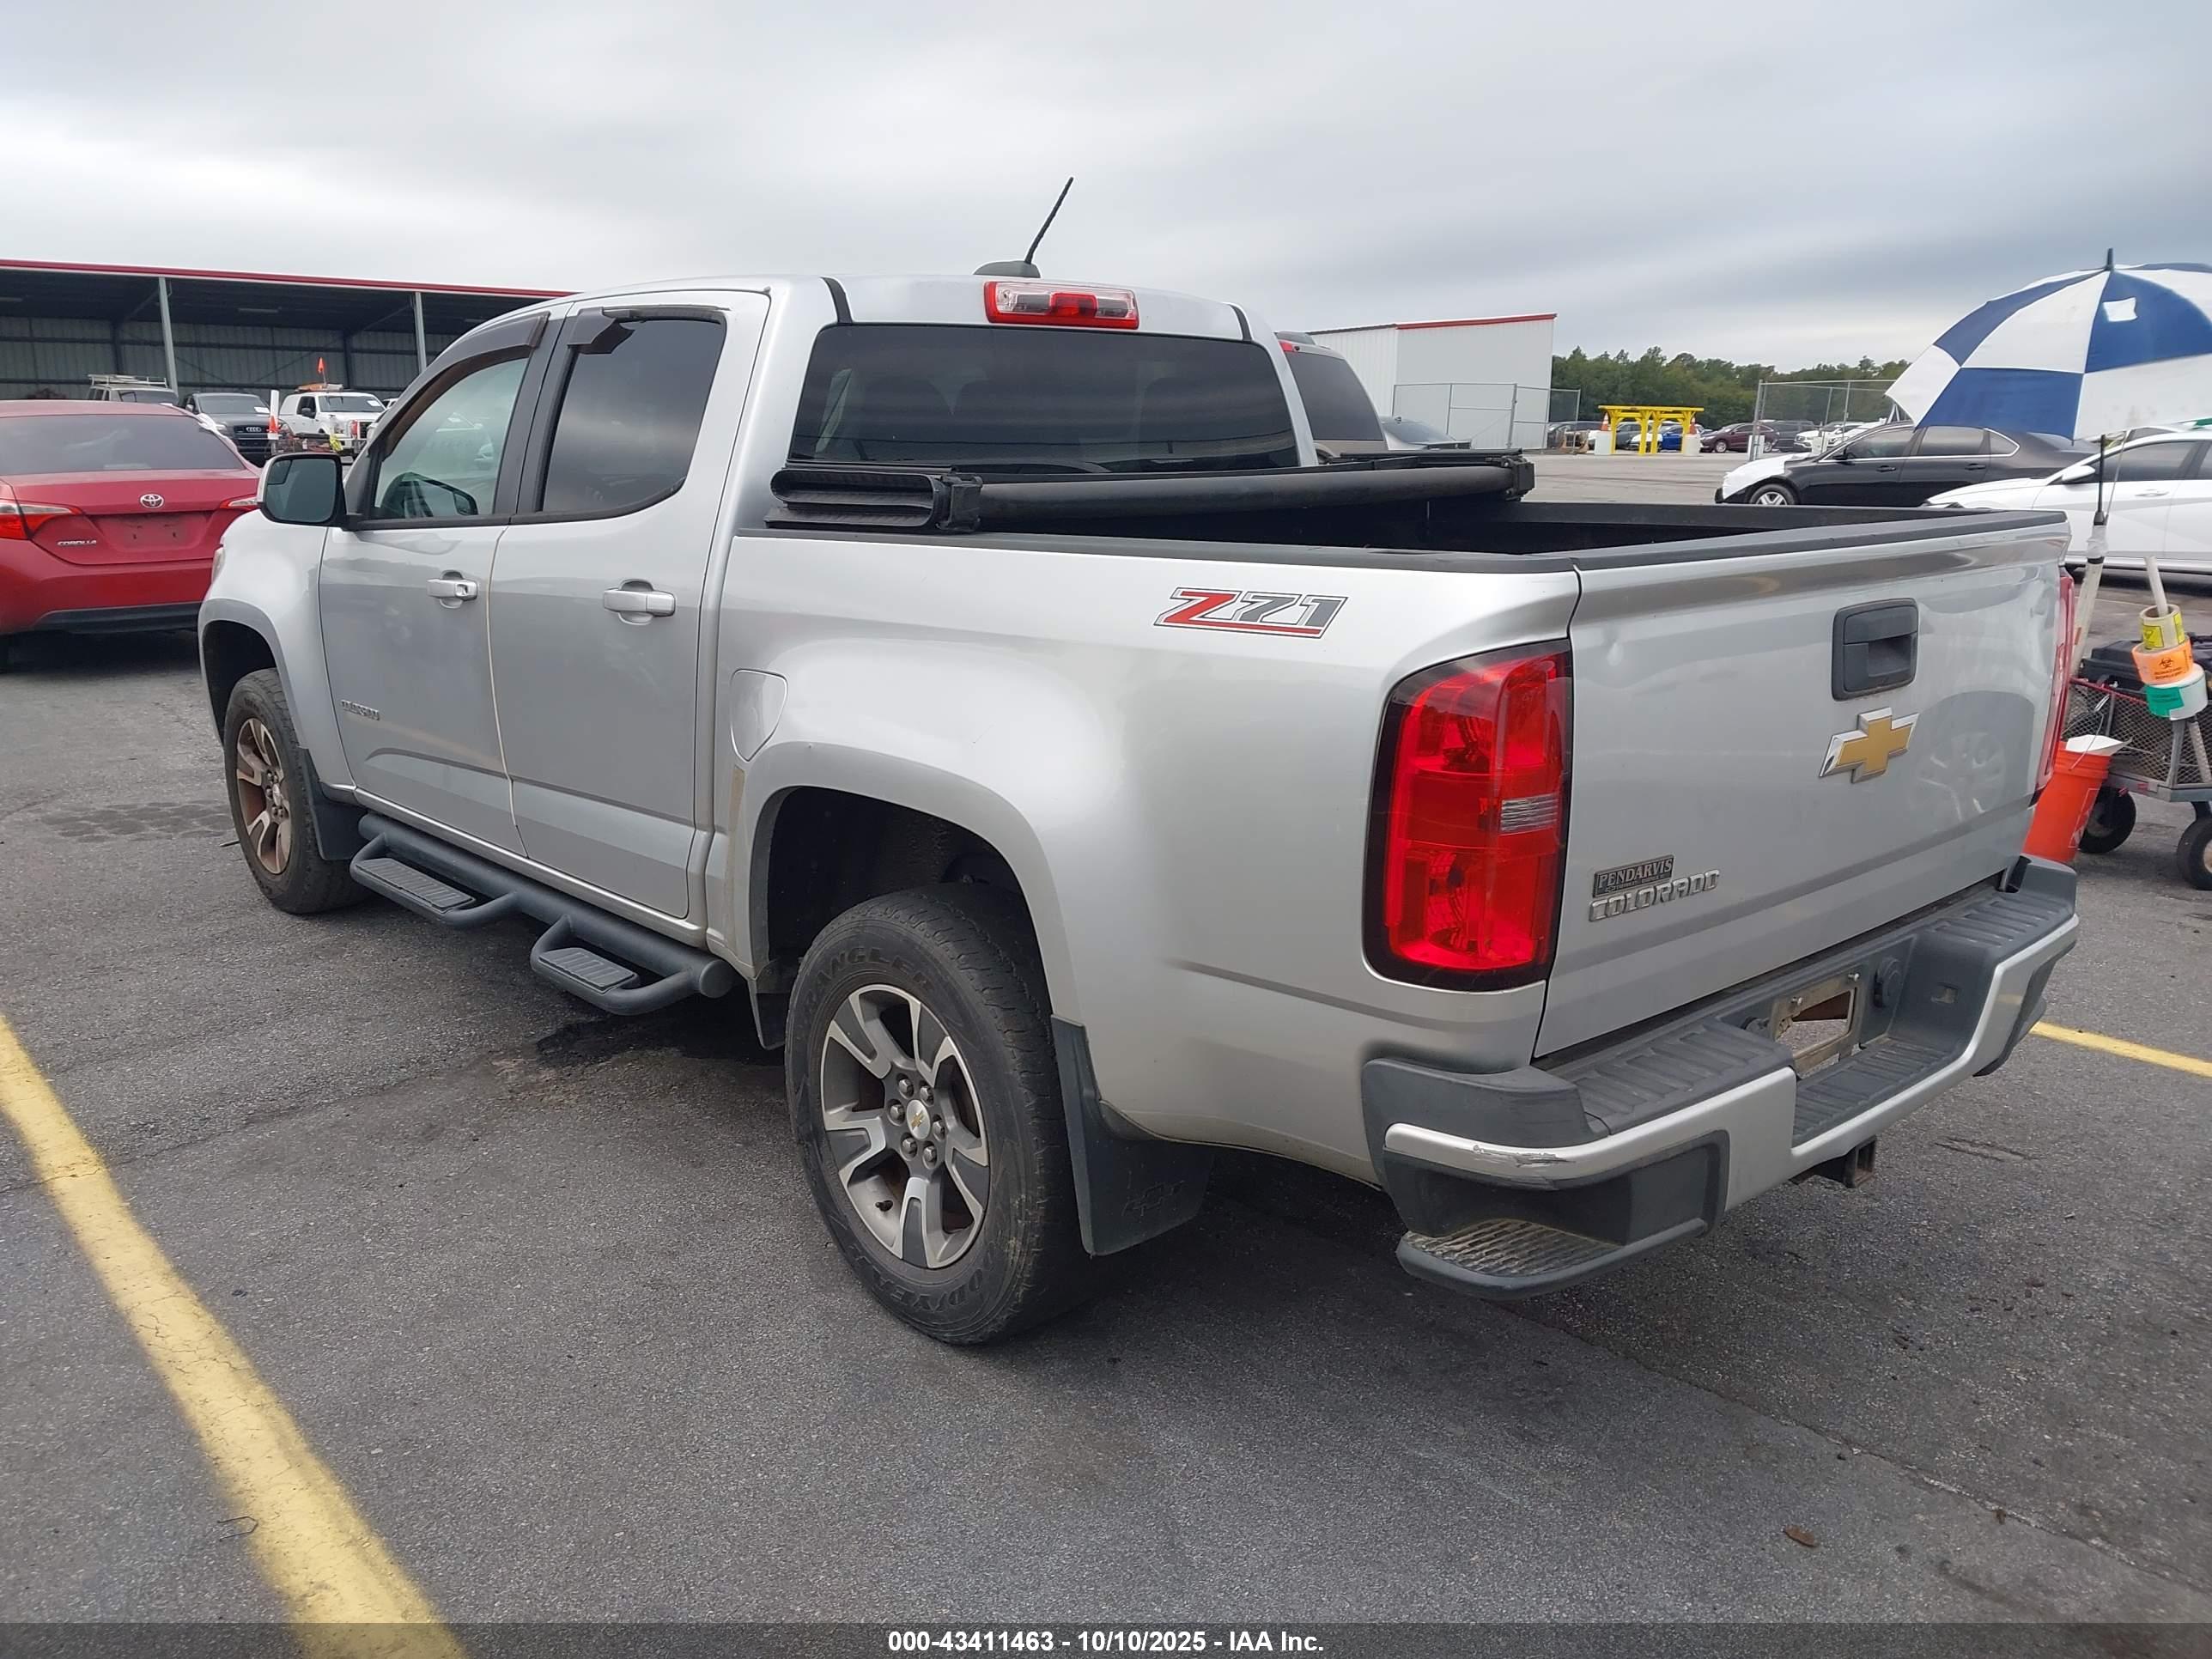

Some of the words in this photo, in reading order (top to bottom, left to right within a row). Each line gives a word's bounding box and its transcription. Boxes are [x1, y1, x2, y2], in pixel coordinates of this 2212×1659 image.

[1153, 587, 1349, 639] Z71
[1589, 869, 1720, 922] COLORADO
[1598, 858, 1674, 889] PENDARVIS
